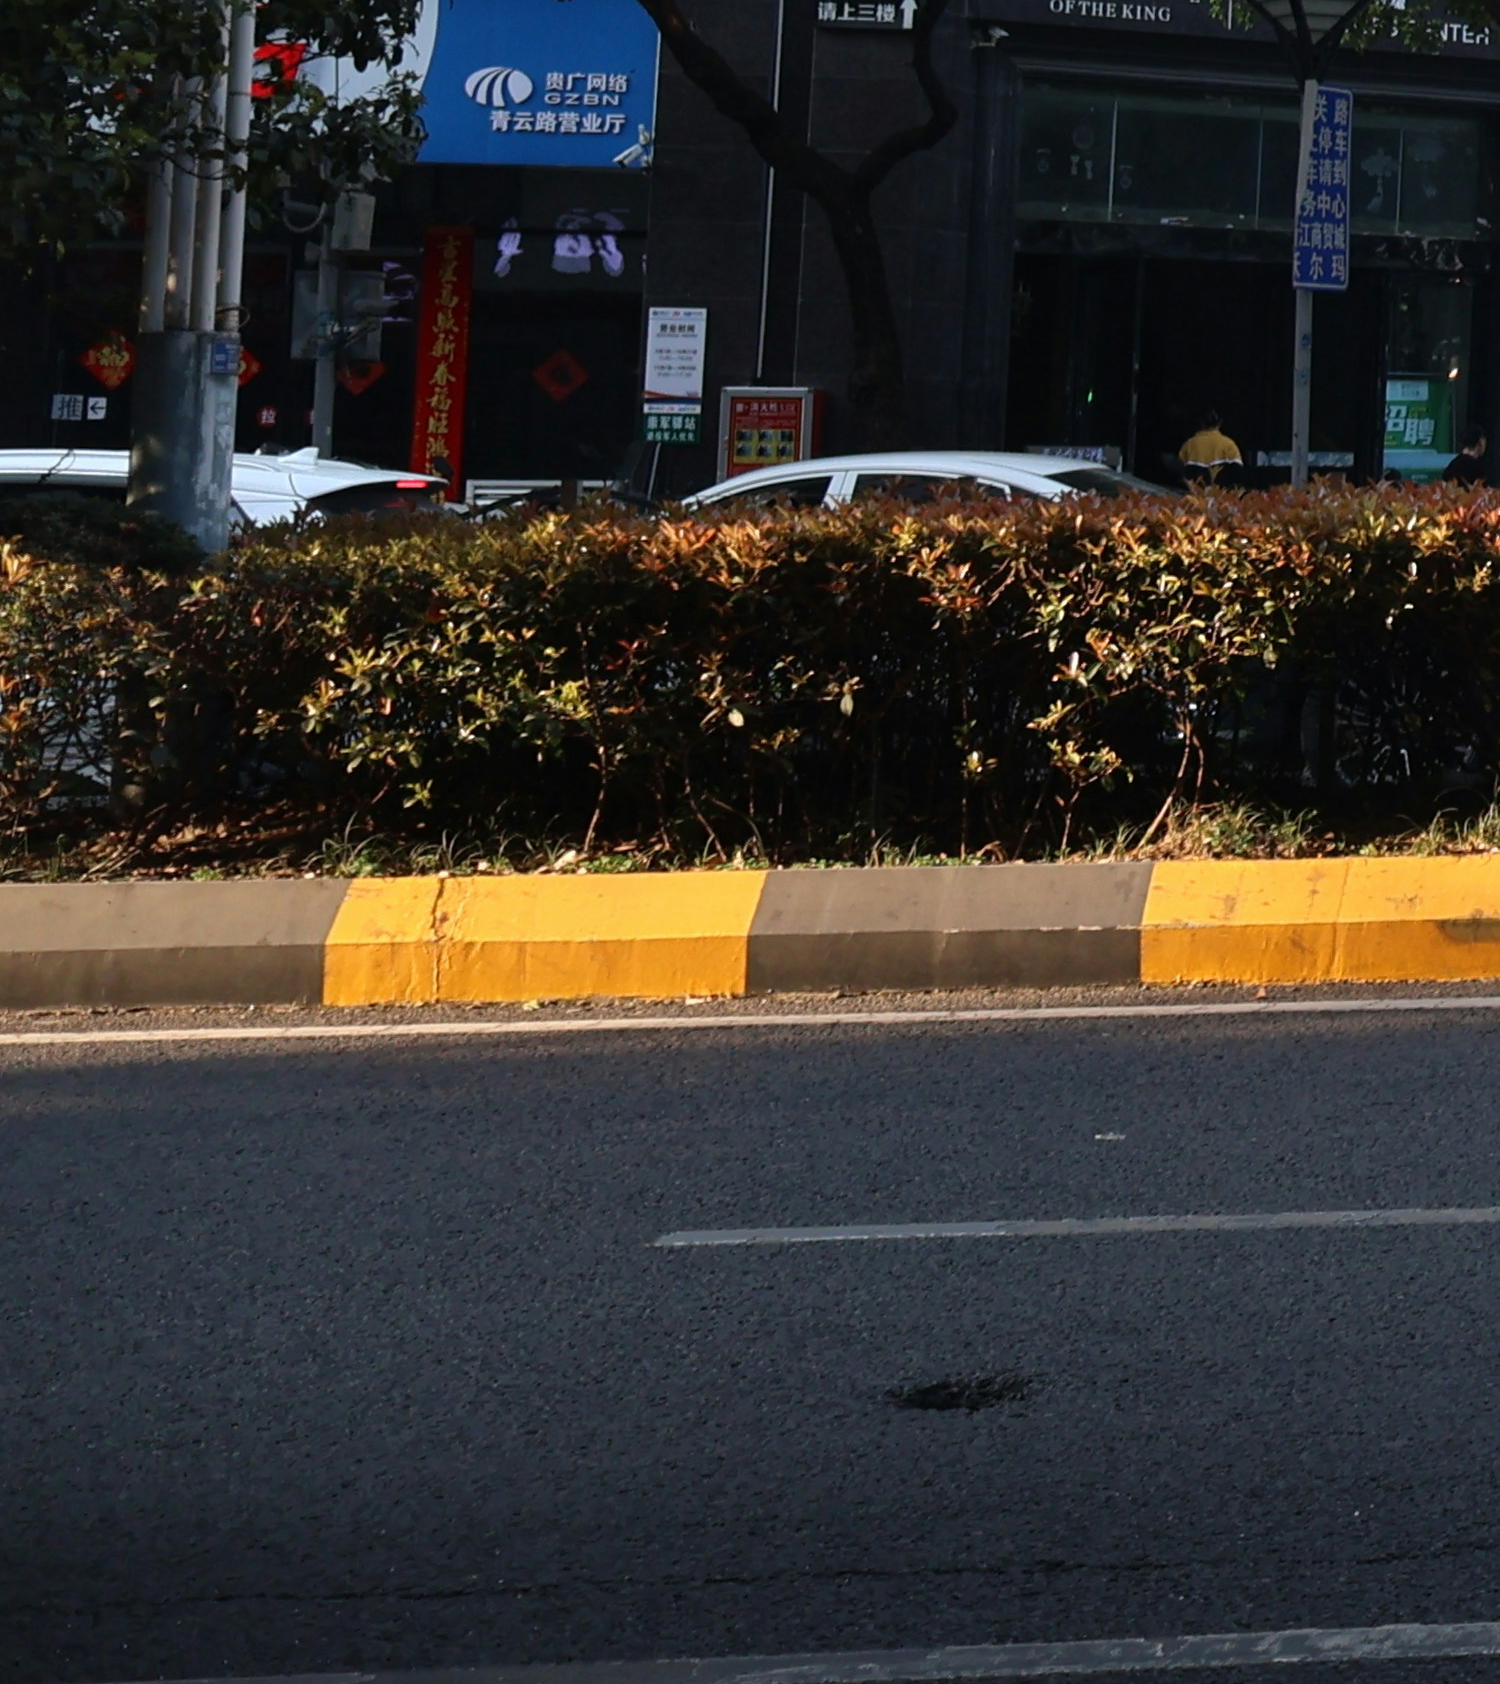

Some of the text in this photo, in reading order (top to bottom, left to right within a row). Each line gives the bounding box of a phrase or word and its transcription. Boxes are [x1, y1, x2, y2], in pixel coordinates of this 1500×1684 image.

[817, 1, 896, 23] 请上三楼
[1077, 0, 1117, 18] THE
[1121, 6, 1171, 22] KING
[545, 73, 628, 93] 贵广网络
[544, 94, 619, 106] GZBN
[490, 110, 626, 134] 青云路营业厅
